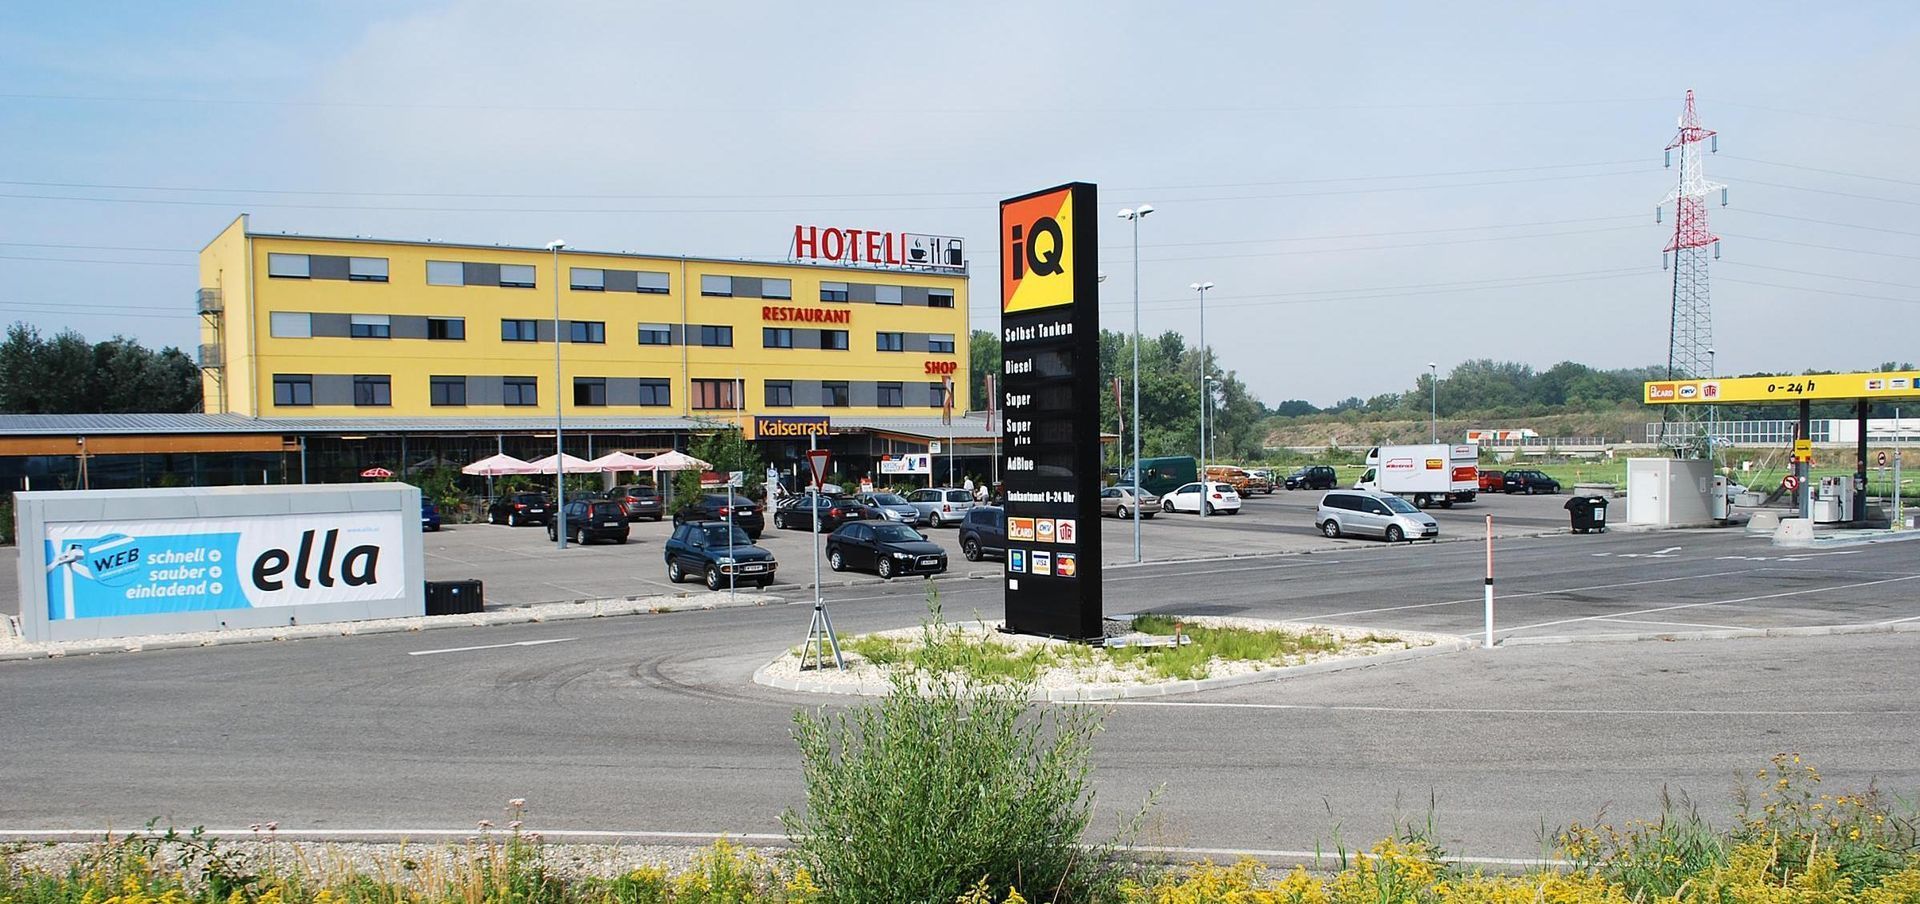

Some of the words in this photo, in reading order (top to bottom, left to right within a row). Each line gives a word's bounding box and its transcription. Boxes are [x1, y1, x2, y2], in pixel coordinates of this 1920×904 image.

[796, 225, 900, 264] HOTEL
[1012, 216, 1064, 280] iQ
[762, 306, 851, 324] RESTAURANT
[1005, 326, 1034, 342] Selbst
[1038, 321, 1073, 337] Tanken
[924, 361, 958, 374] SHOP
[1005, 358, 1031, 374] Diesel
[1807, 380, 1815, 391] h
[1006, 393, 1031, 408] Super
[759, 419, 829, 436] Kaiserrast
[1006, 419, 1031, 435] Super
[1014, 435, 1031, 446] plus
[1007, 457, 1034, 471] AdBlue
[1007, 491, 1045, 502] Tankautomat
[1063, 492, 1075, 503] Uhr
[147, 548, 206, 565] schnell
[252, 529, 380, 591] ella
[149, 566, 206, 581] sauber
[125, 581, 207, 599] einladend
